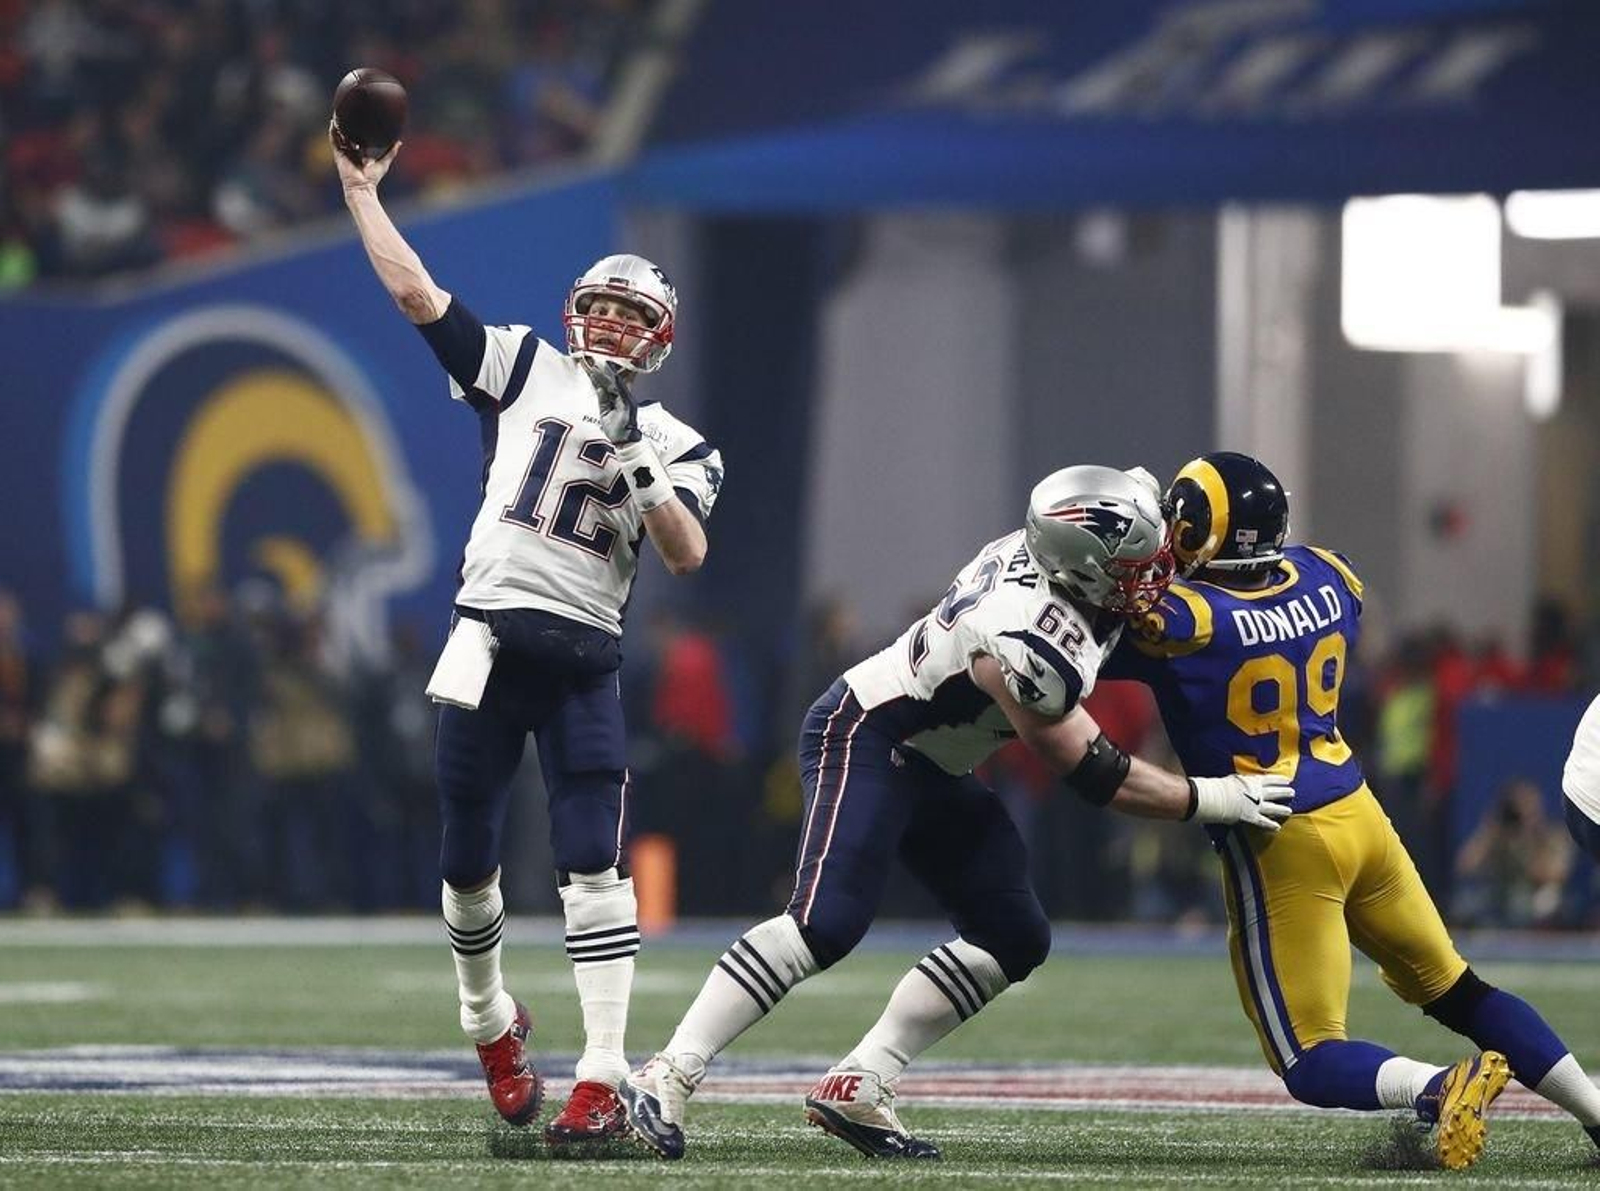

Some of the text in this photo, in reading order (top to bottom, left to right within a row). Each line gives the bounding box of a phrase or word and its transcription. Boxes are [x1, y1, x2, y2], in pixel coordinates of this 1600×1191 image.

[500, 416, 631, 562] 12
[1033, 601, 1087, 662] 62
[1232, 584, 1342, 647] DONALD
[1226, 631, 1352, 784] 99
